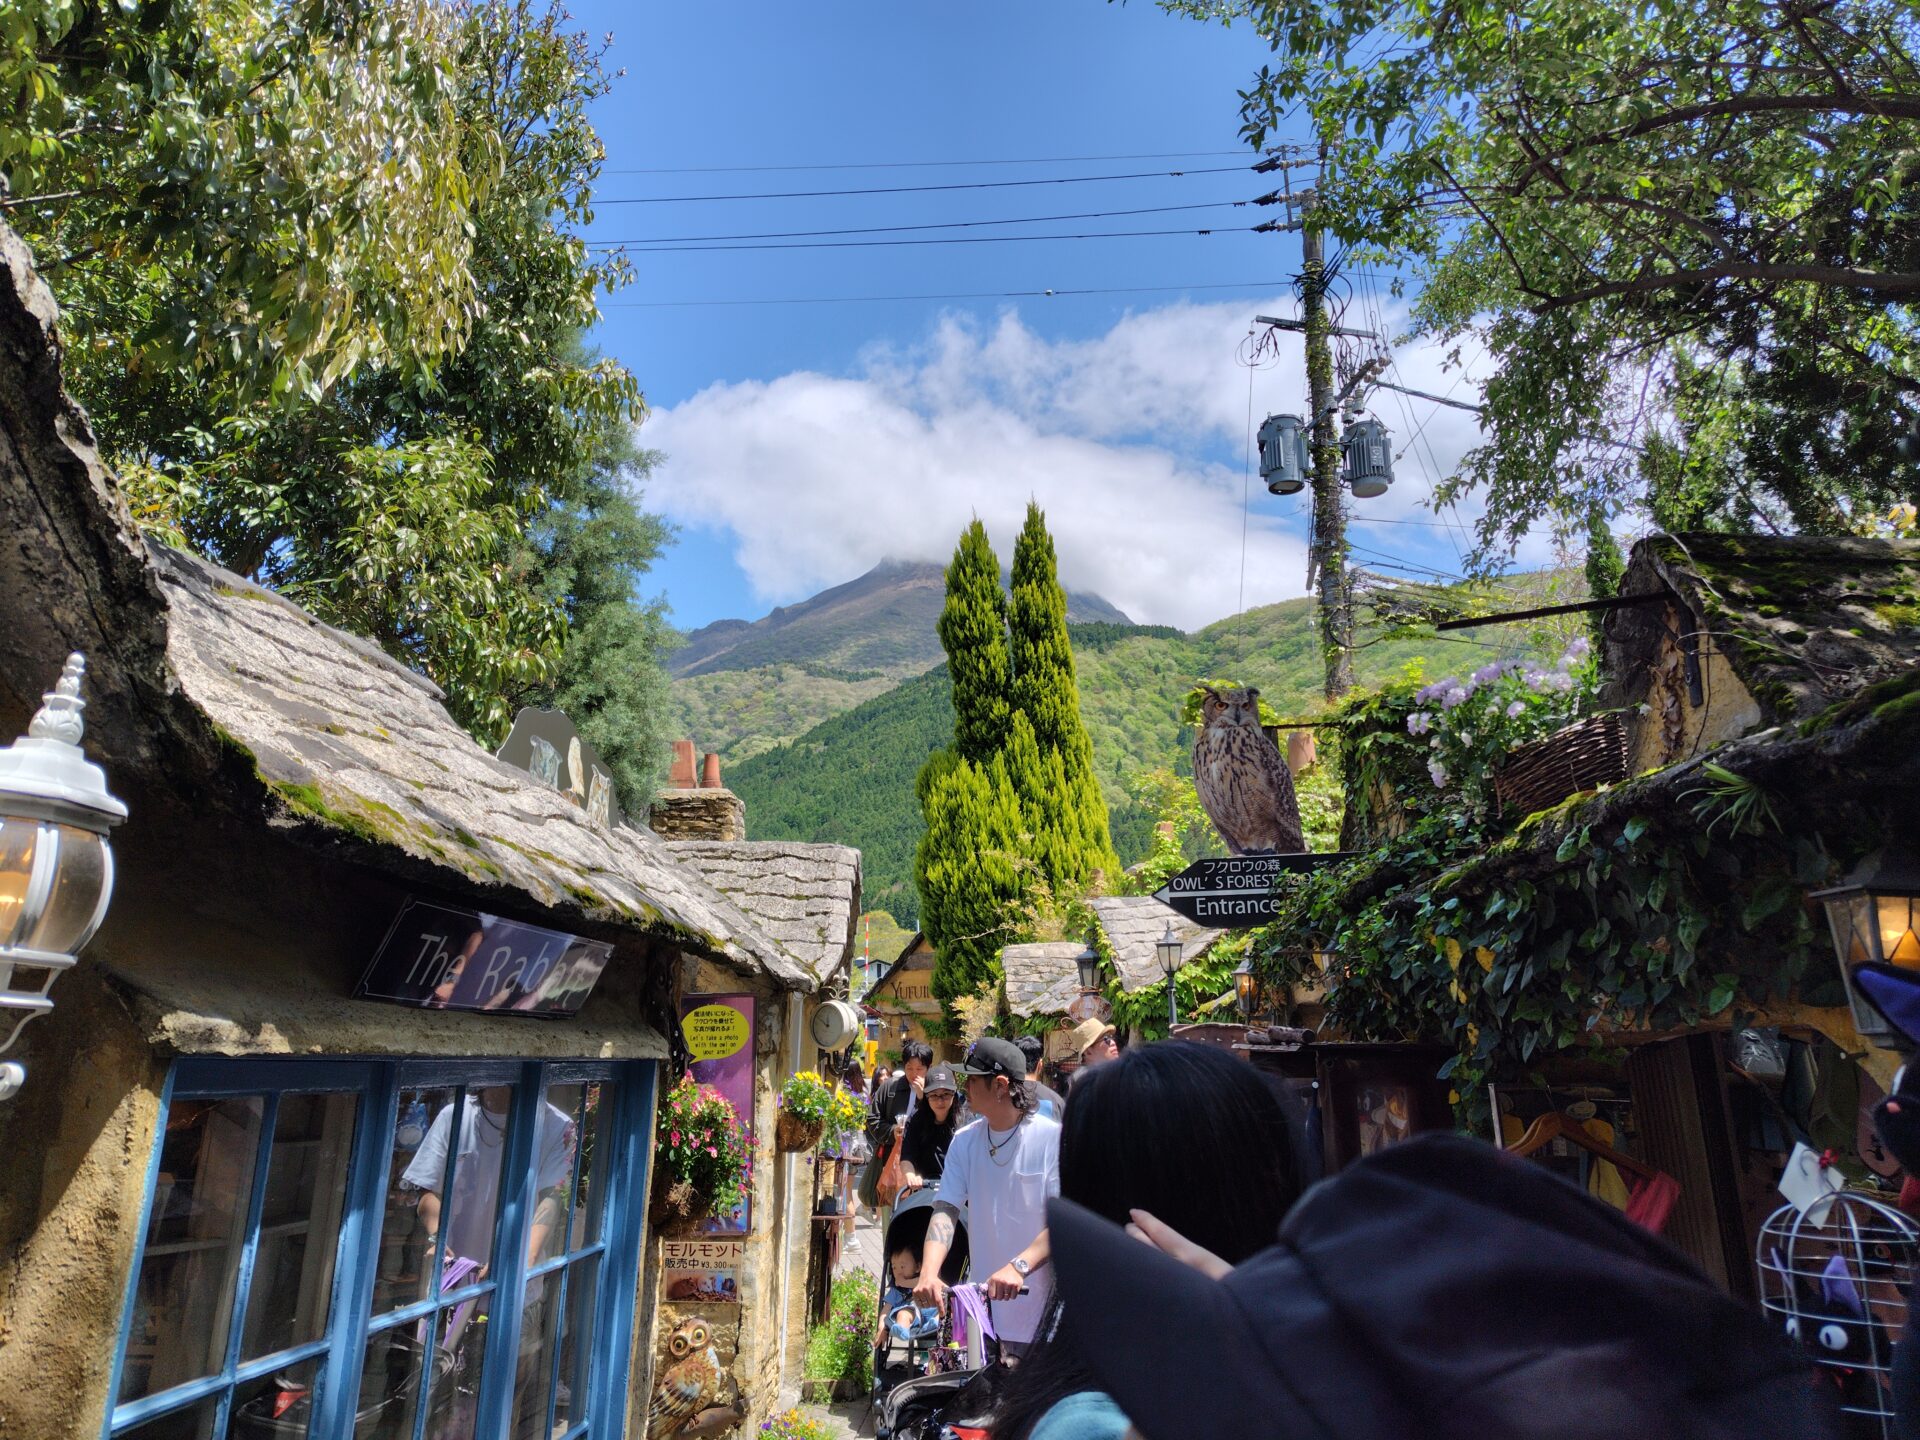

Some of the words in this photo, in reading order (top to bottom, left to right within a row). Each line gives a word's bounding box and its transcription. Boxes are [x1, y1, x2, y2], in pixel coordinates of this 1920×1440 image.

[1203, 859, 1281, 874] フクロウの森
[1226, 873, 1278, 889] FOREST
[1195, 897, 1281, 916] Entrance
[405, 933, 467, 988] The
[665, 1243, 742, 1258] モルモット
[665, 1258, 699, 1269] 販売中
